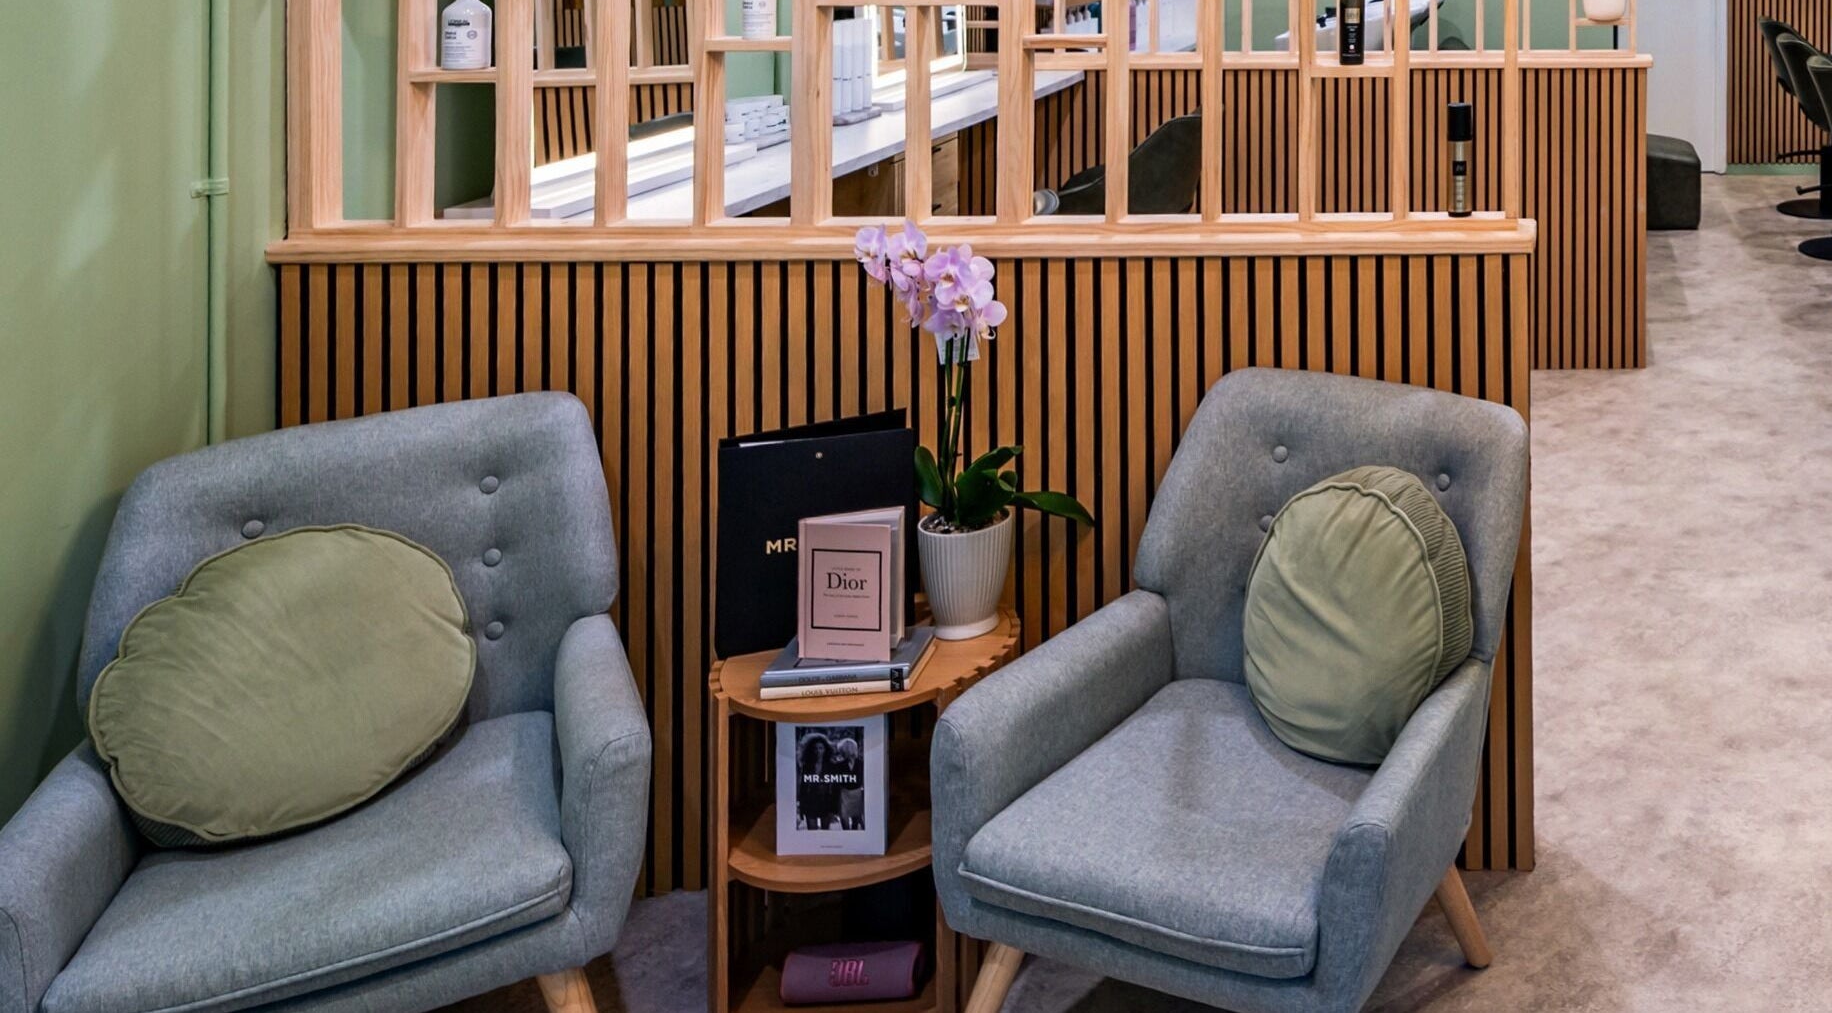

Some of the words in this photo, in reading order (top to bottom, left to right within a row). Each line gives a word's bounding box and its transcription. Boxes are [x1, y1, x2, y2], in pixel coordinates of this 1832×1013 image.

[826, 572, 867, 591] Dior
[801, 689, 823, 697] LOUIS
[825, 686, 859, 696] VUITTON
[829, 959, 869, 986] JBL
